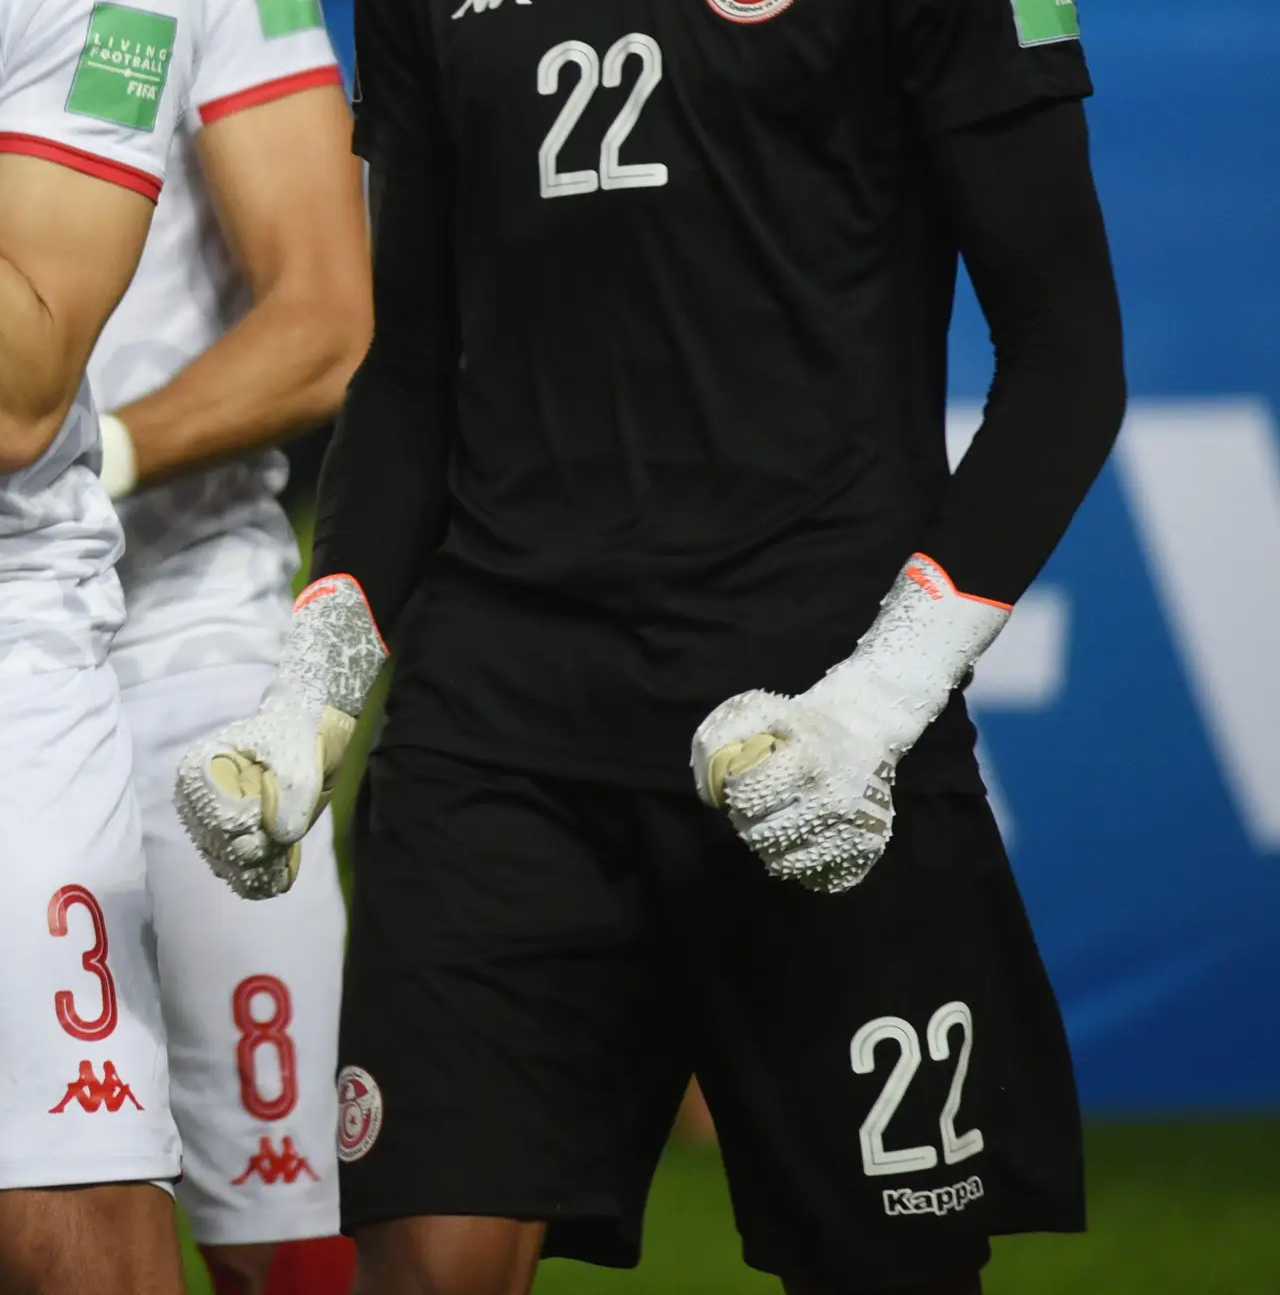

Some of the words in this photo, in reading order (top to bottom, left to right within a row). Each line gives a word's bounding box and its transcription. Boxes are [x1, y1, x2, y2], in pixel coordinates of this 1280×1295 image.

[89, 44, 164, 75] FOOTBALL
[93, 32, 168, 62] LIVING
[126, 80, 158, 101] FIFA
[537, 32, 668, 199] 22
[47, 884, 118, 1042] 3
[232, 972, 298, 1122] 8
[850, 1001, 984, 1176] 22
[882, 1175, 984, 1216] Kappa
